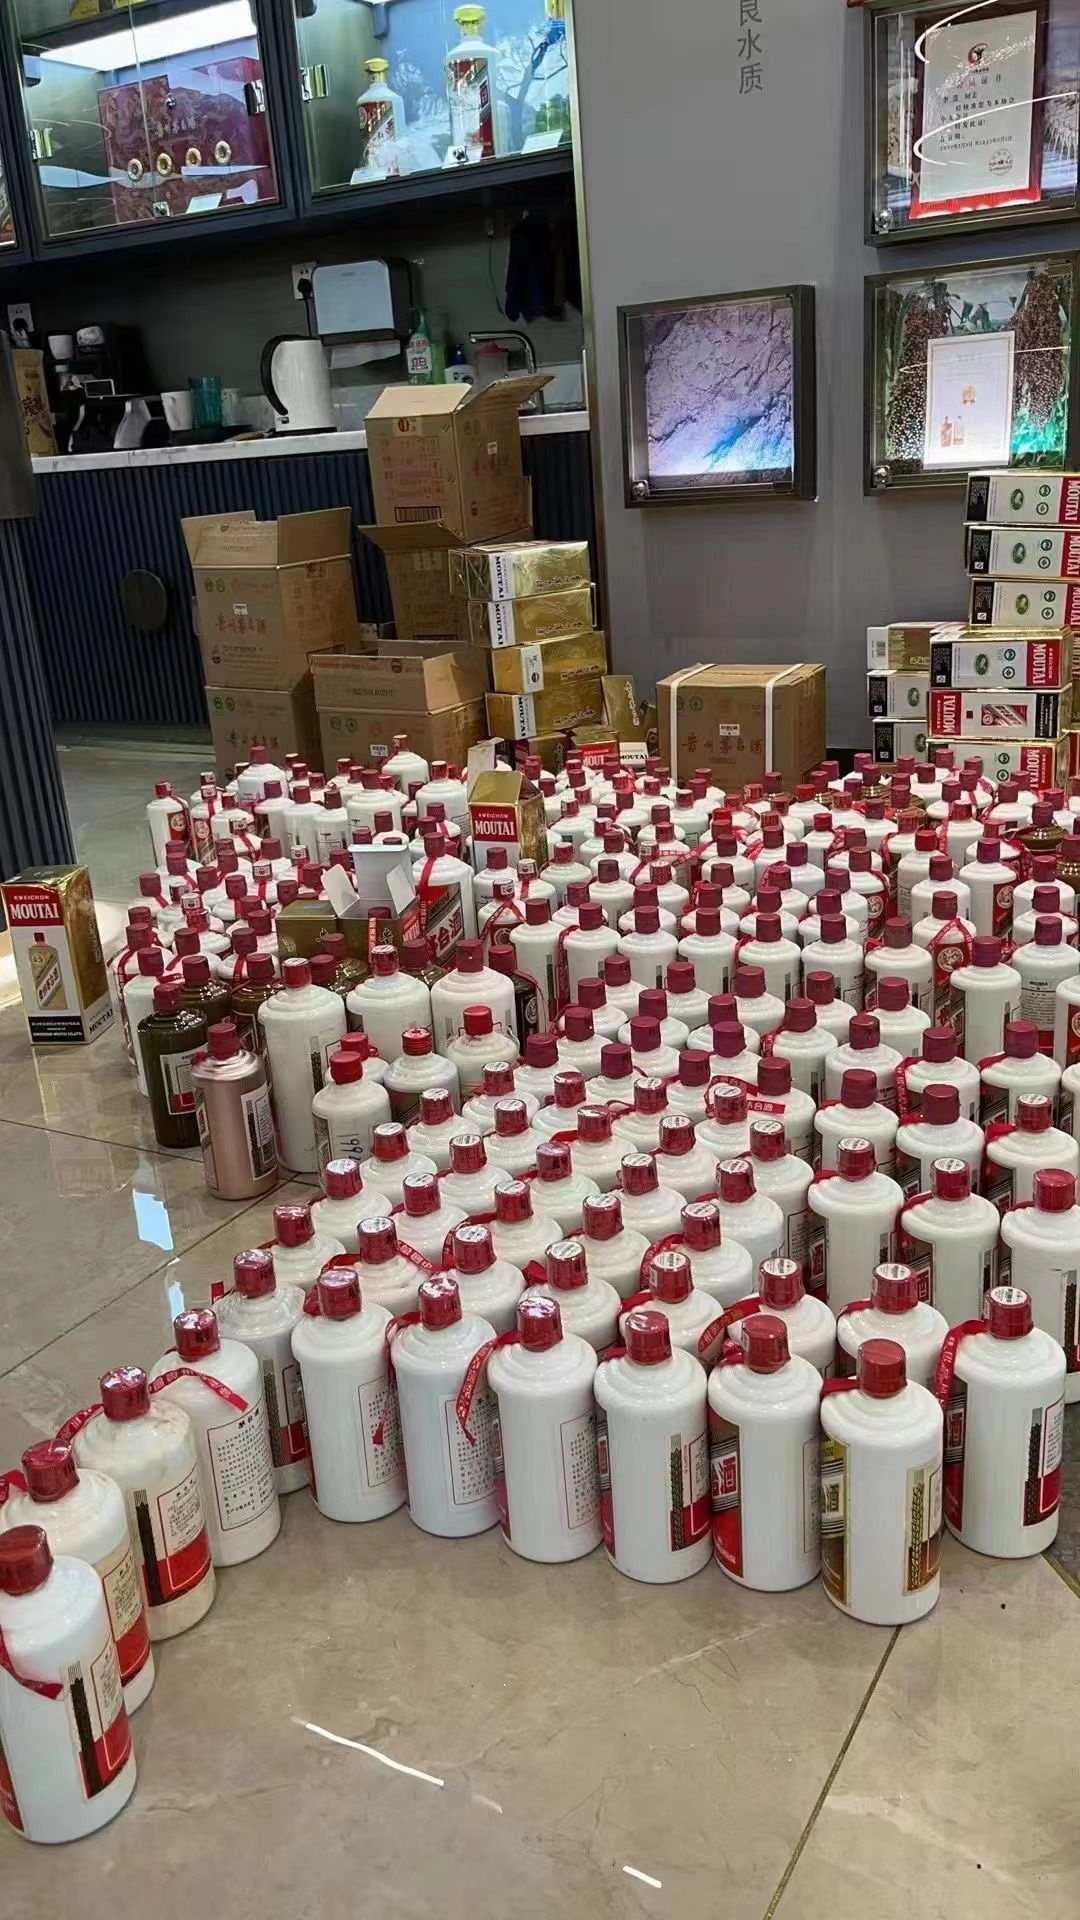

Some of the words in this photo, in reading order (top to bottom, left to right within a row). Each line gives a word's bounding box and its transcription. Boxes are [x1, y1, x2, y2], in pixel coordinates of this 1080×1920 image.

[495, 556, 505, 599] MOUTAI
[495, 603, 504, 645] MOUTAI
[1032, 643, 1046, 685] MOUTAI
[517, 696, 526, 737] MOUTAI
[943, 695, 956, 733] MOUTAI
[583, 755, 604, 766] MOUT
[1026, 749, 1039, 788] MOUTAI
[475, 820, 515, 836] MOUTAI
[10, 903, 60, 919] MOUTAI
[89, 1008, 114, 1034] MOUTAI
